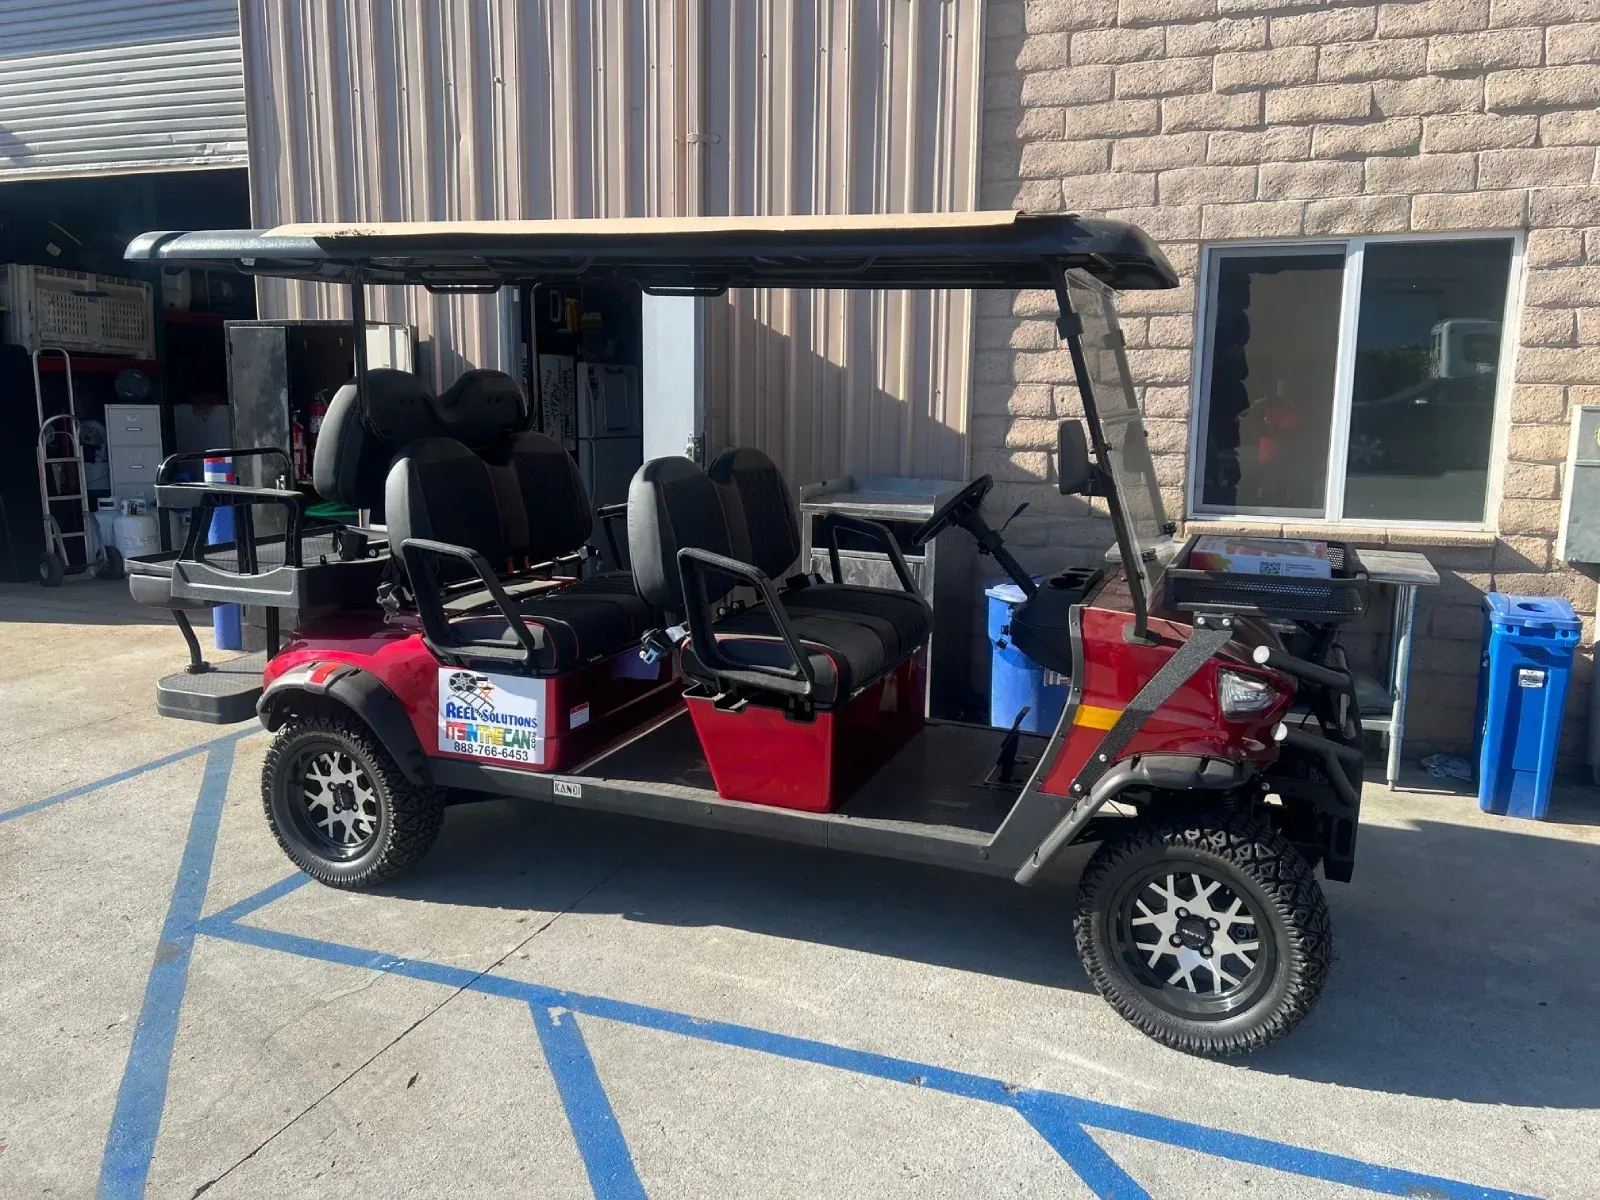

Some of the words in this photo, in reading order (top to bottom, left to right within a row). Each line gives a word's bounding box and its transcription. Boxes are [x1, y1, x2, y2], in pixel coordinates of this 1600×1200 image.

[445, 701, 478, 721] REEL
[481, 709, 538, 729] SOLUTIONS
[453, 741, 529, 762] 888-766-6453
[555, 782, 581, 796] KANDI
